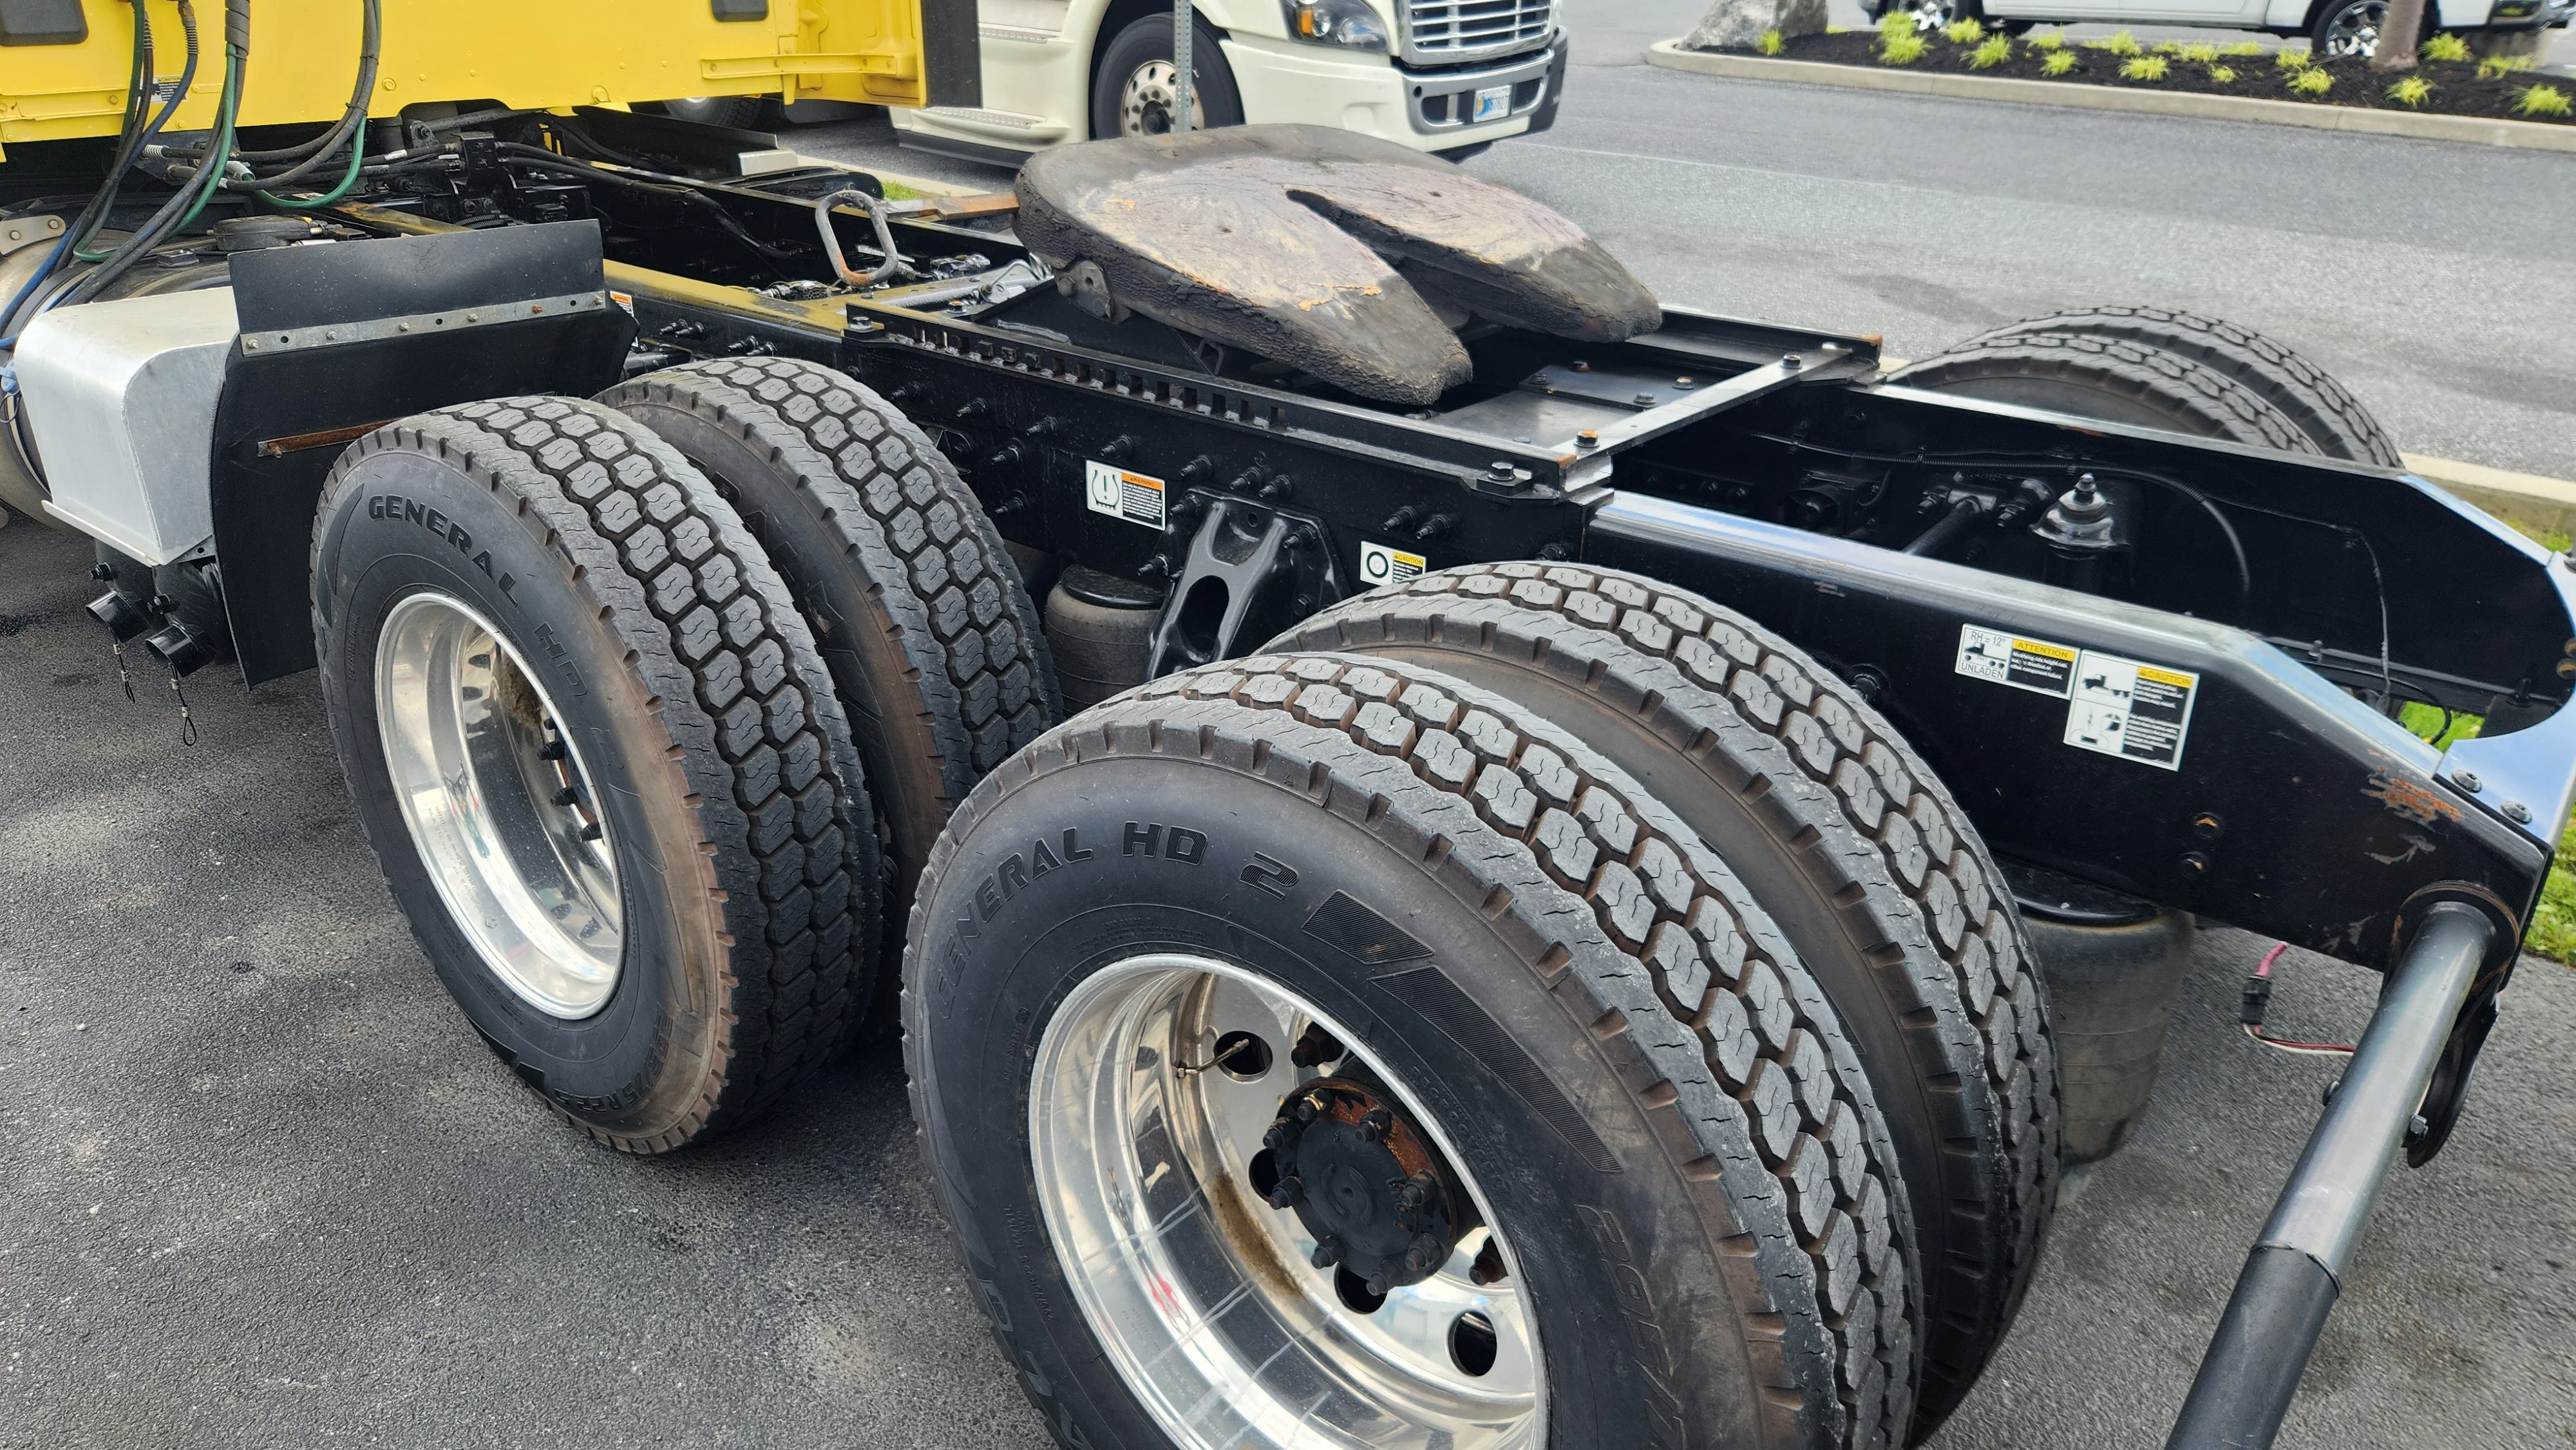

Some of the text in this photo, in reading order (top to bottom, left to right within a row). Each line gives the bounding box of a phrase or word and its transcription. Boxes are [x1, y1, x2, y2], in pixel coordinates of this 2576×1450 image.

[1397, 554, 1423, 565] CAUTION
[368, 494, 518, 608] GENERAL
[534, 621, 587, 696] HD
[1971, 631, 1983, 642] RH
[2017, 642, 2069, 658] ATTENTION
[1961, 662, 2004, 679] UNLADEN
[2148, 670, 2191, 685] CAUTION
[929, 827, 1094, 1019] GENERAL
[1122, 820, 1209, 866] HD
[1239, 851, 1300, 900] 2
